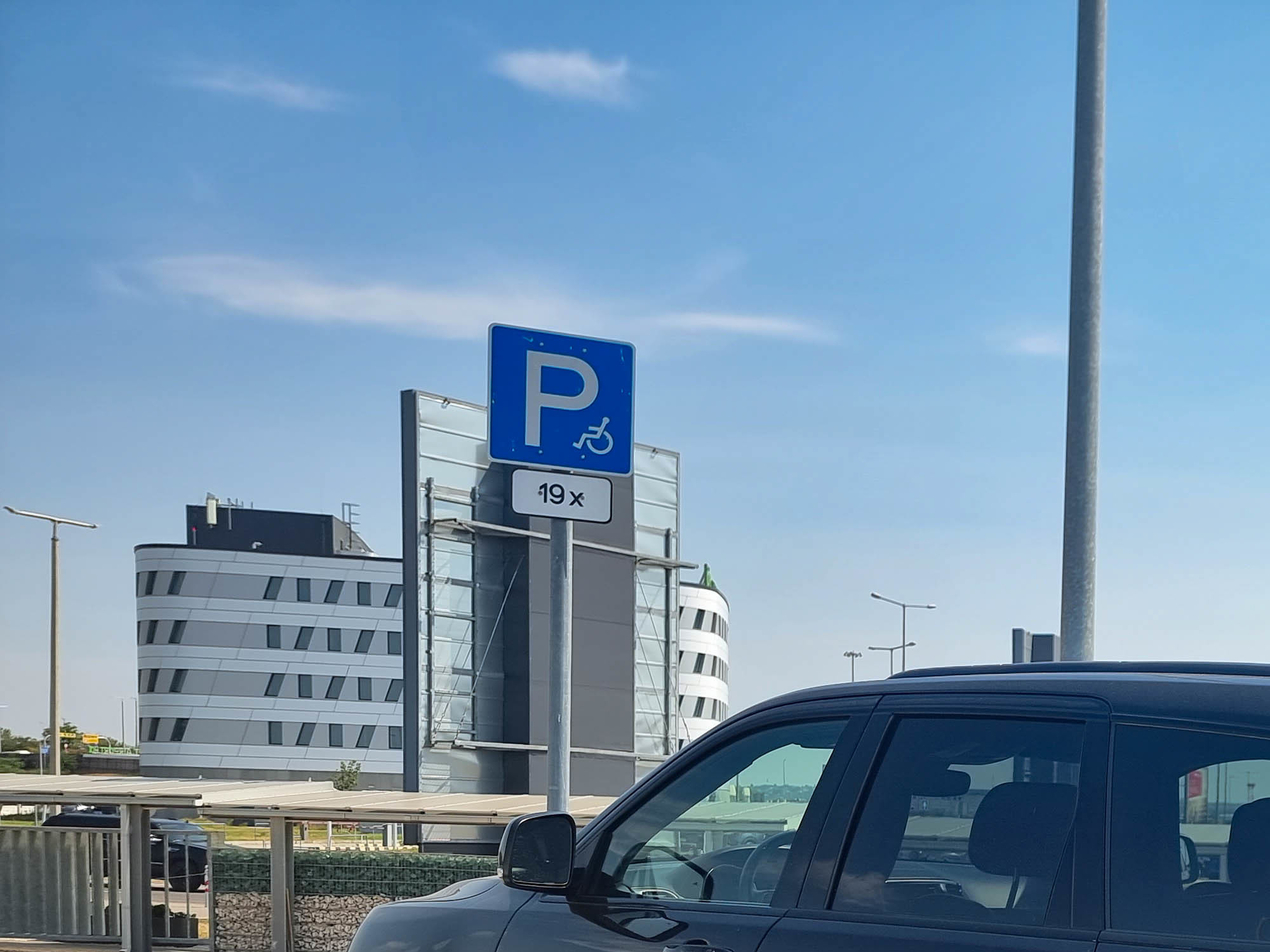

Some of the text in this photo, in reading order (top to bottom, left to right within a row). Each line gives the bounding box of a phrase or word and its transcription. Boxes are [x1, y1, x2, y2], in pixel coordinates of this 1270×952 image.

[525, 349, 599, 447] P
[539, 483, 584, 507] 19 x
